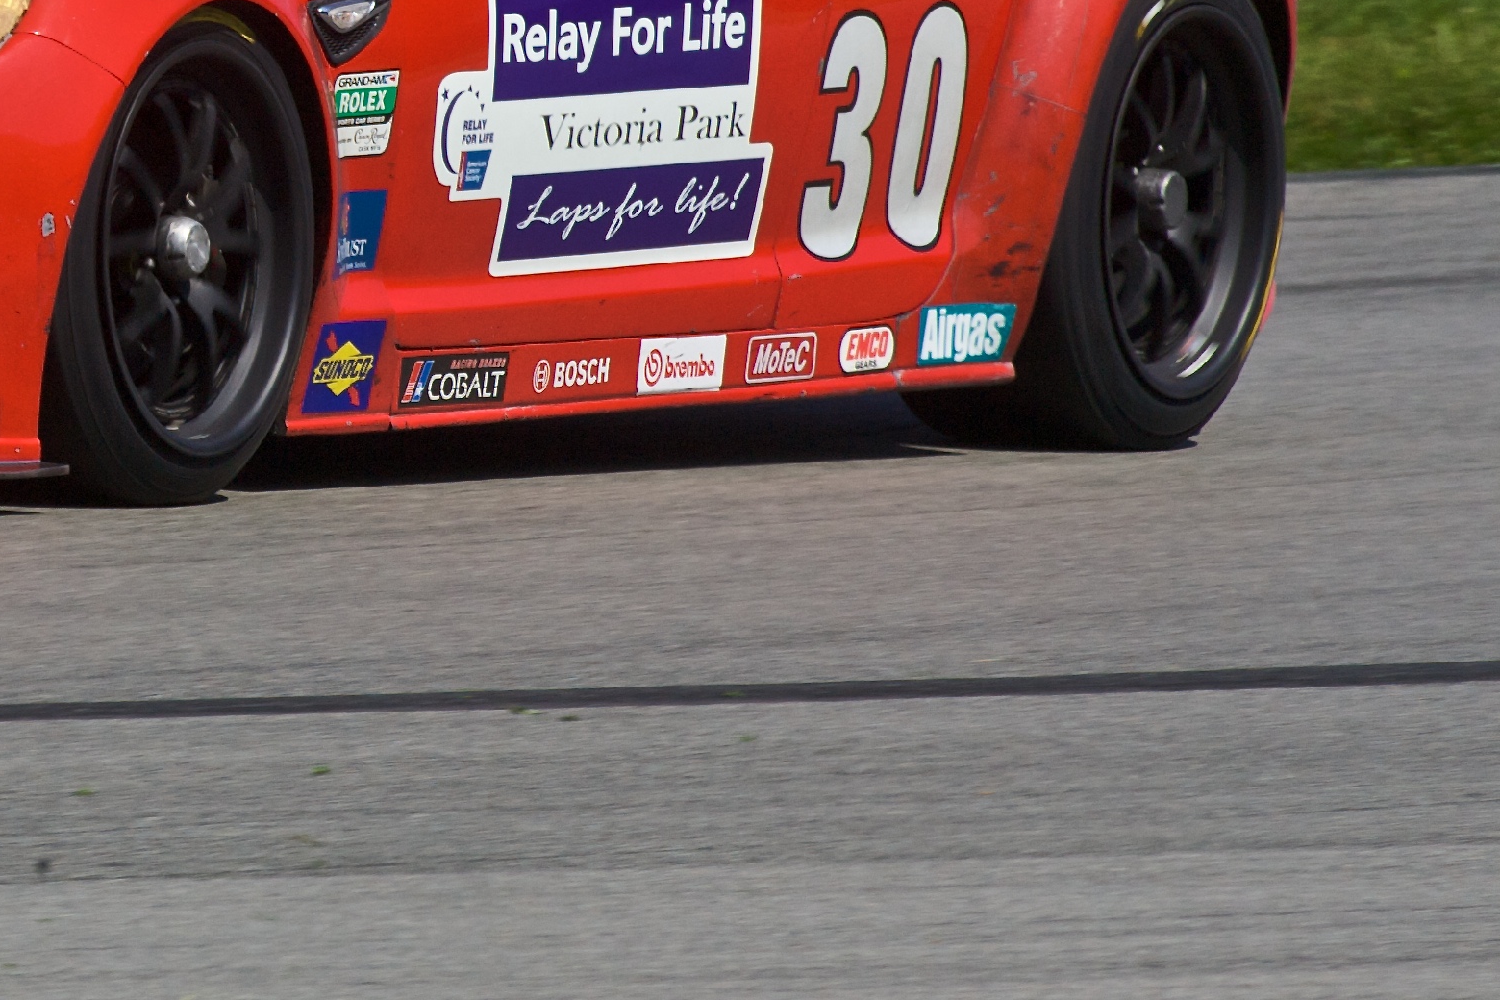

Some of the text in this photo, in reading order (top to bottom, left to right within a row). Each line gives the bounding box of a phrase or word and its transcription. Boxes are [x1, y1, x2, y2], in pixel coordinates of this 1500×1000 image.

[502, 8, 601, 74] Relay
[612, 6, 672, 57] For
[338, 89, 388, 113] ROLEX
[462, 119, 487, 131] RELAY
[462, 132, 494, 145] FOR LIFE
[542, 101, 746, 151] Victoria Park
[798, 0, 969, 263] 30
[516, 172, 750, 241] Laps for life!
[845, 328, 890, 362] EMCO
[920, 307, 1006, 363] Airgas
[312, 354, 374, 383] SUNOCO
[552, 357, 611, 388] BOSCH
[663, 354, 715, 380] brembo
[754, 340, 810, 375] MoTeC
[854, 359, 878, 370] GEARS
[427, 370, 506, 401] COBALT
